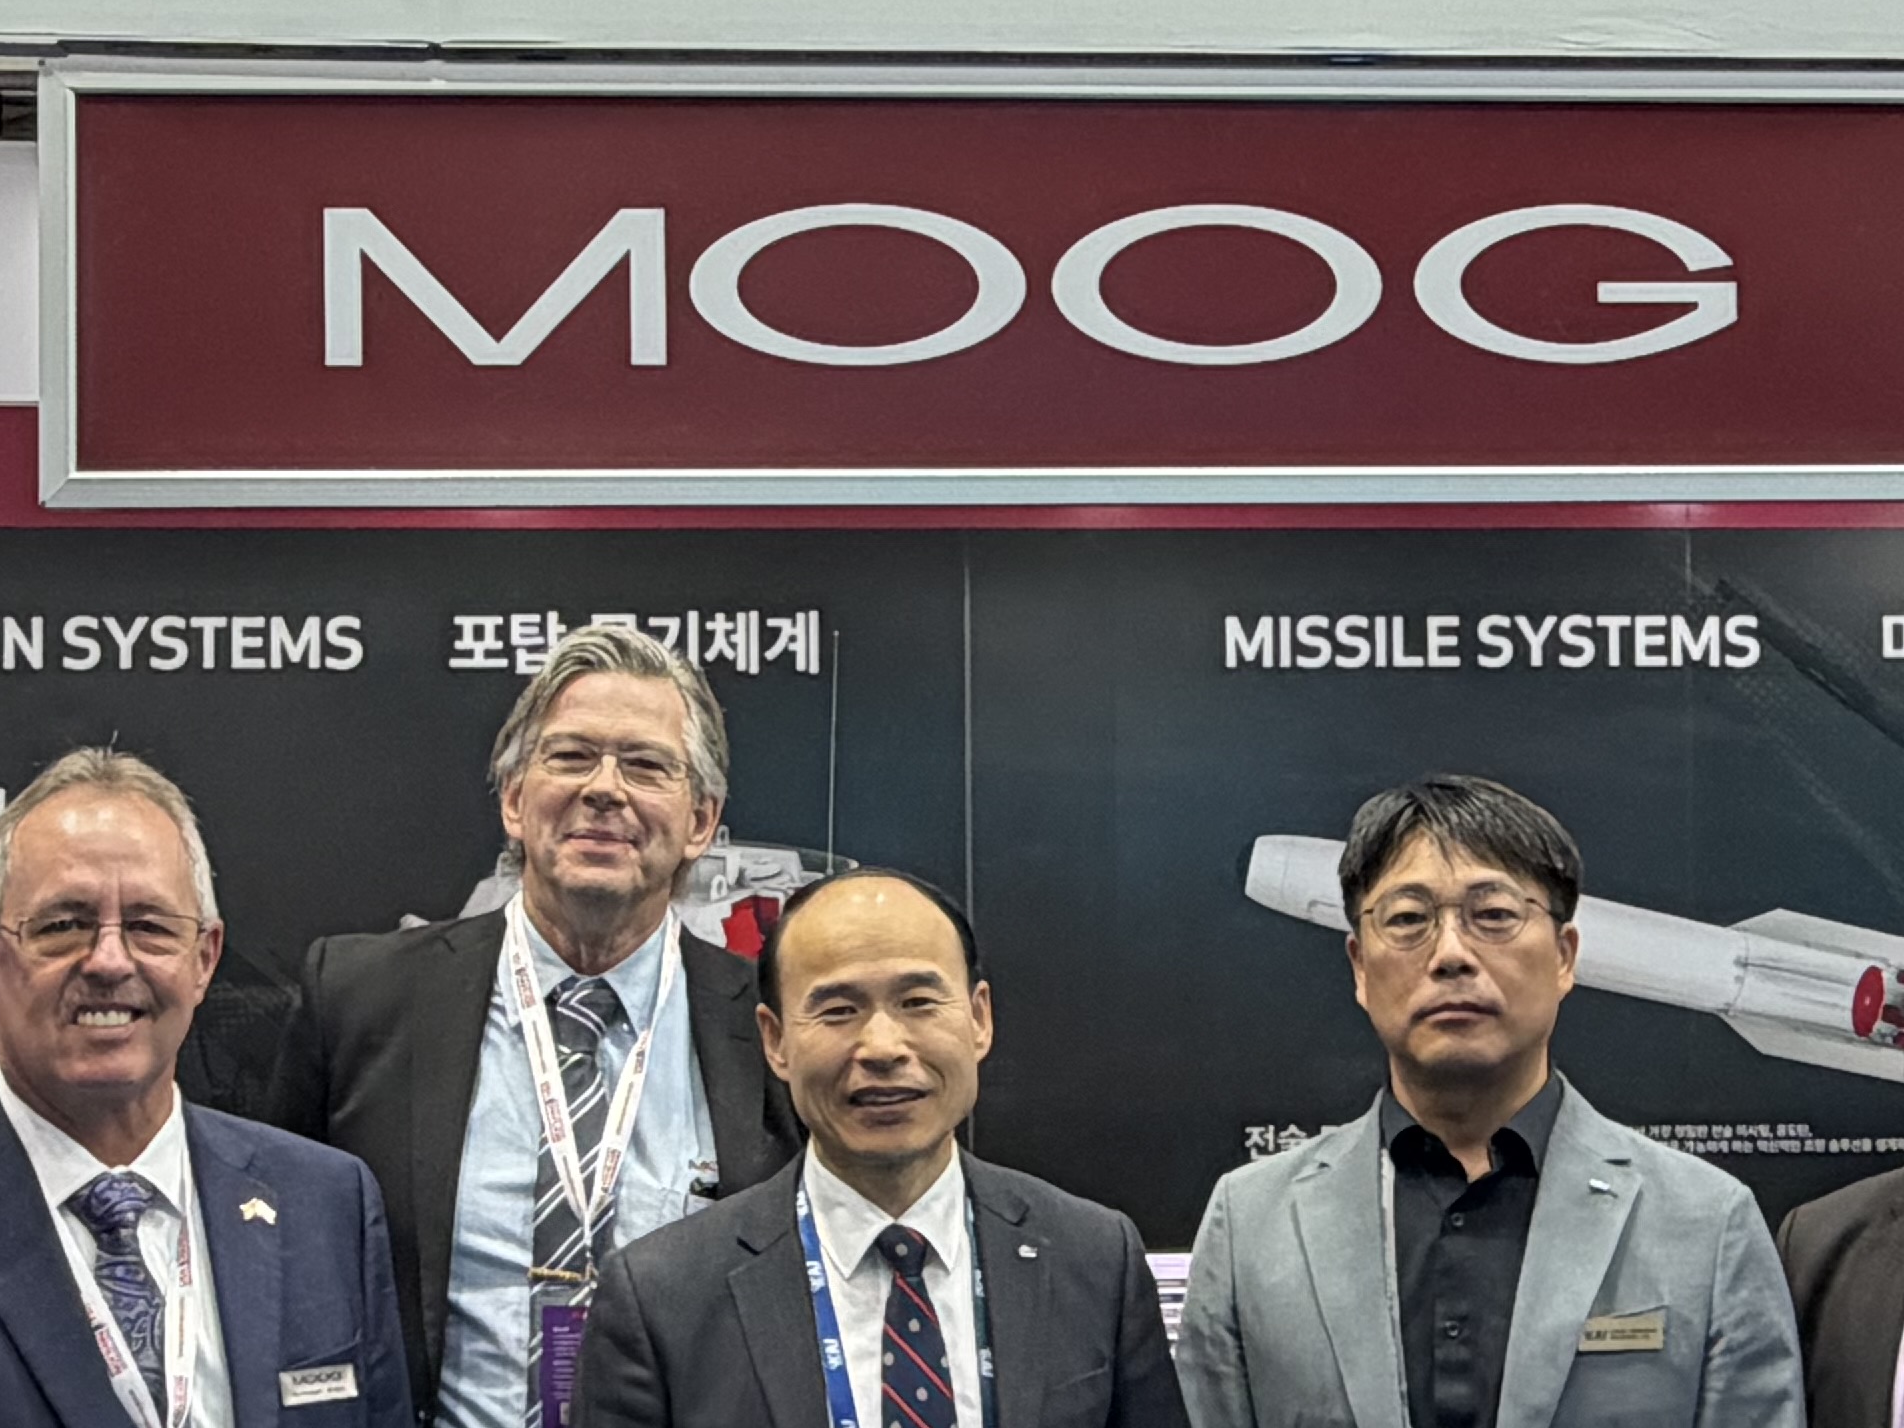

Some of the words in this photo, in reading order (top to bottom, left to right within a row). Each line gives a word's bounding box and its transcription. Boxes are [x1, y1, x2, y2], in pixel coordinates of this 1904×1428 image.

[322, 202, 1738, 367] MOOG
[62, 615, 364, 671] SYSTEMS
[1224, 614, 1461, 668] MISSILE
[1477, 614, 1761, 668] SYSTEMS
